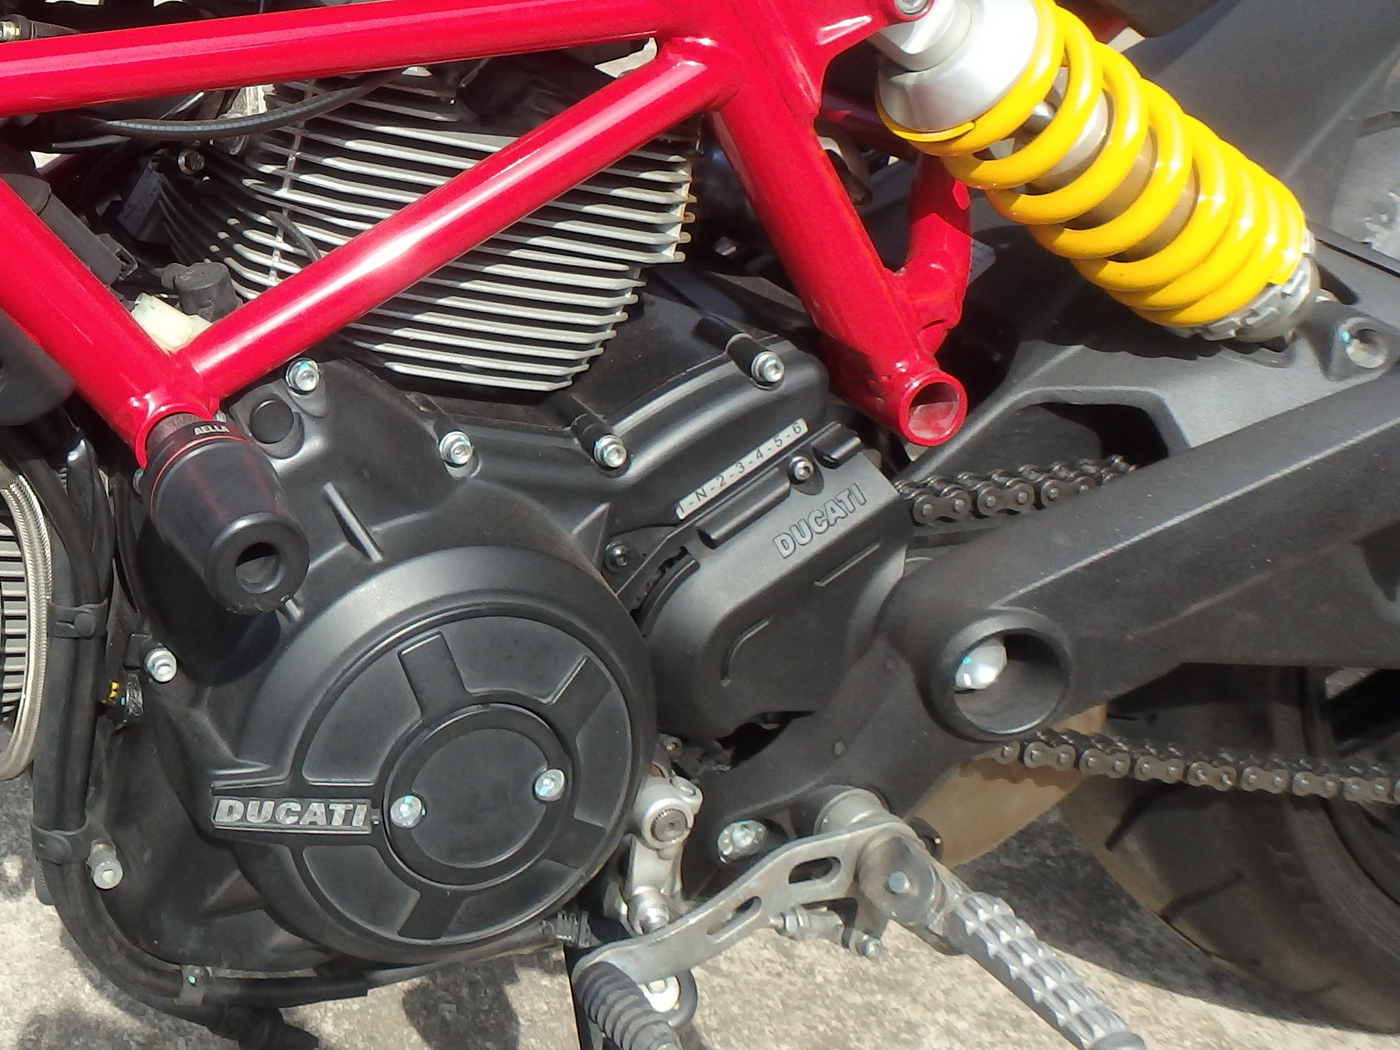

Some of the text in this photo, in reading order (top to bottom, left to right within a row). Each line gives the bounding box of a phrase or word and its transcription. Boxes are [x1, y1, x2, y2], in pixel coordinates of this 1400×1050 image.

[193, 425, 230, 436] AELLA
[772, 482, 867, 559] DUCATI
[214, 799, 368, 826] DUCATI
